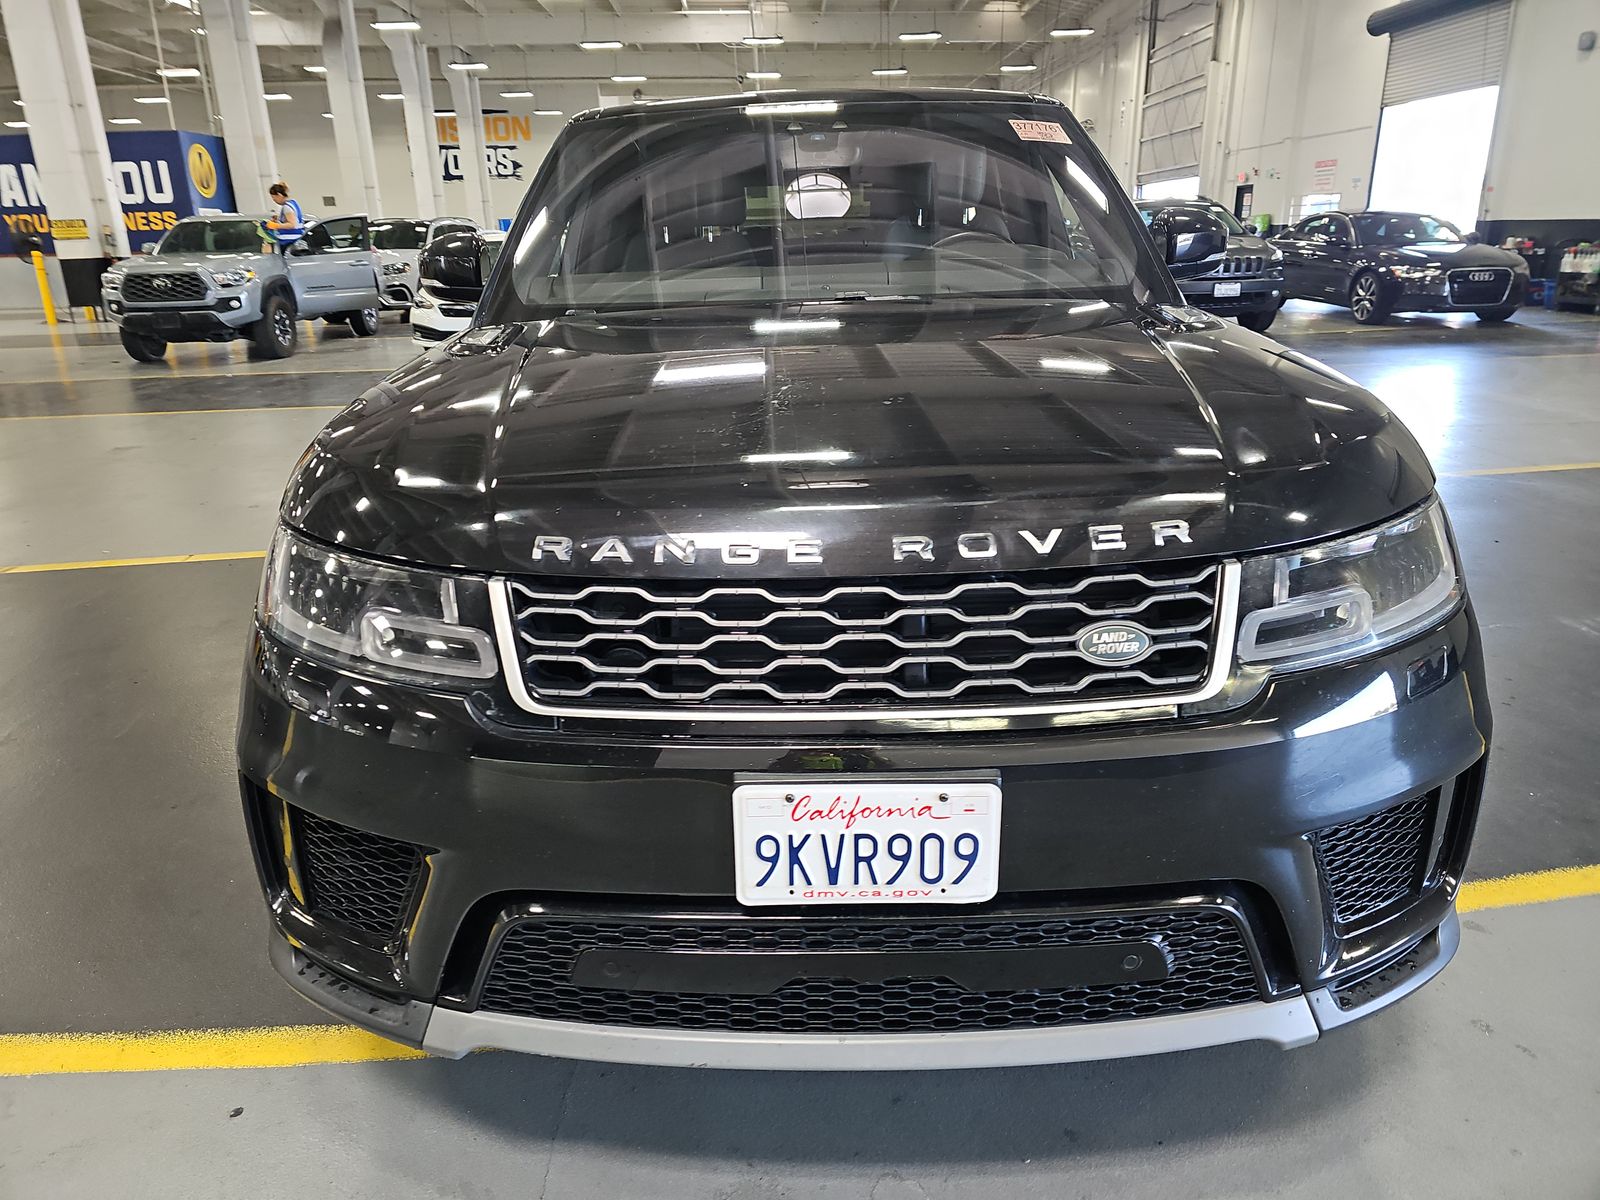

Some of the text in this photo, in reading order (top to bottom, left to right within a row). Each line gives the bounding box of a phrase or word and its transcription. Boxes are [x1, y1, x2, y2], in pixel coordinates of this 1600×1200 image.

[436, 115, 532, 143] ISION
[441, 149, 515, 176] ORS
[113, 161, 174, 204] OU
[532, 519, 1194, 565] RANGE ROVER
[1092, 631, 1128, 643] LAND
[1096, 641, 1140, 654] ROVER
[791, 795, 952, 829] California
[755, 832, 980, 887] 9KVR909
[803, 889, 933, 898] dmv.ca.gov
